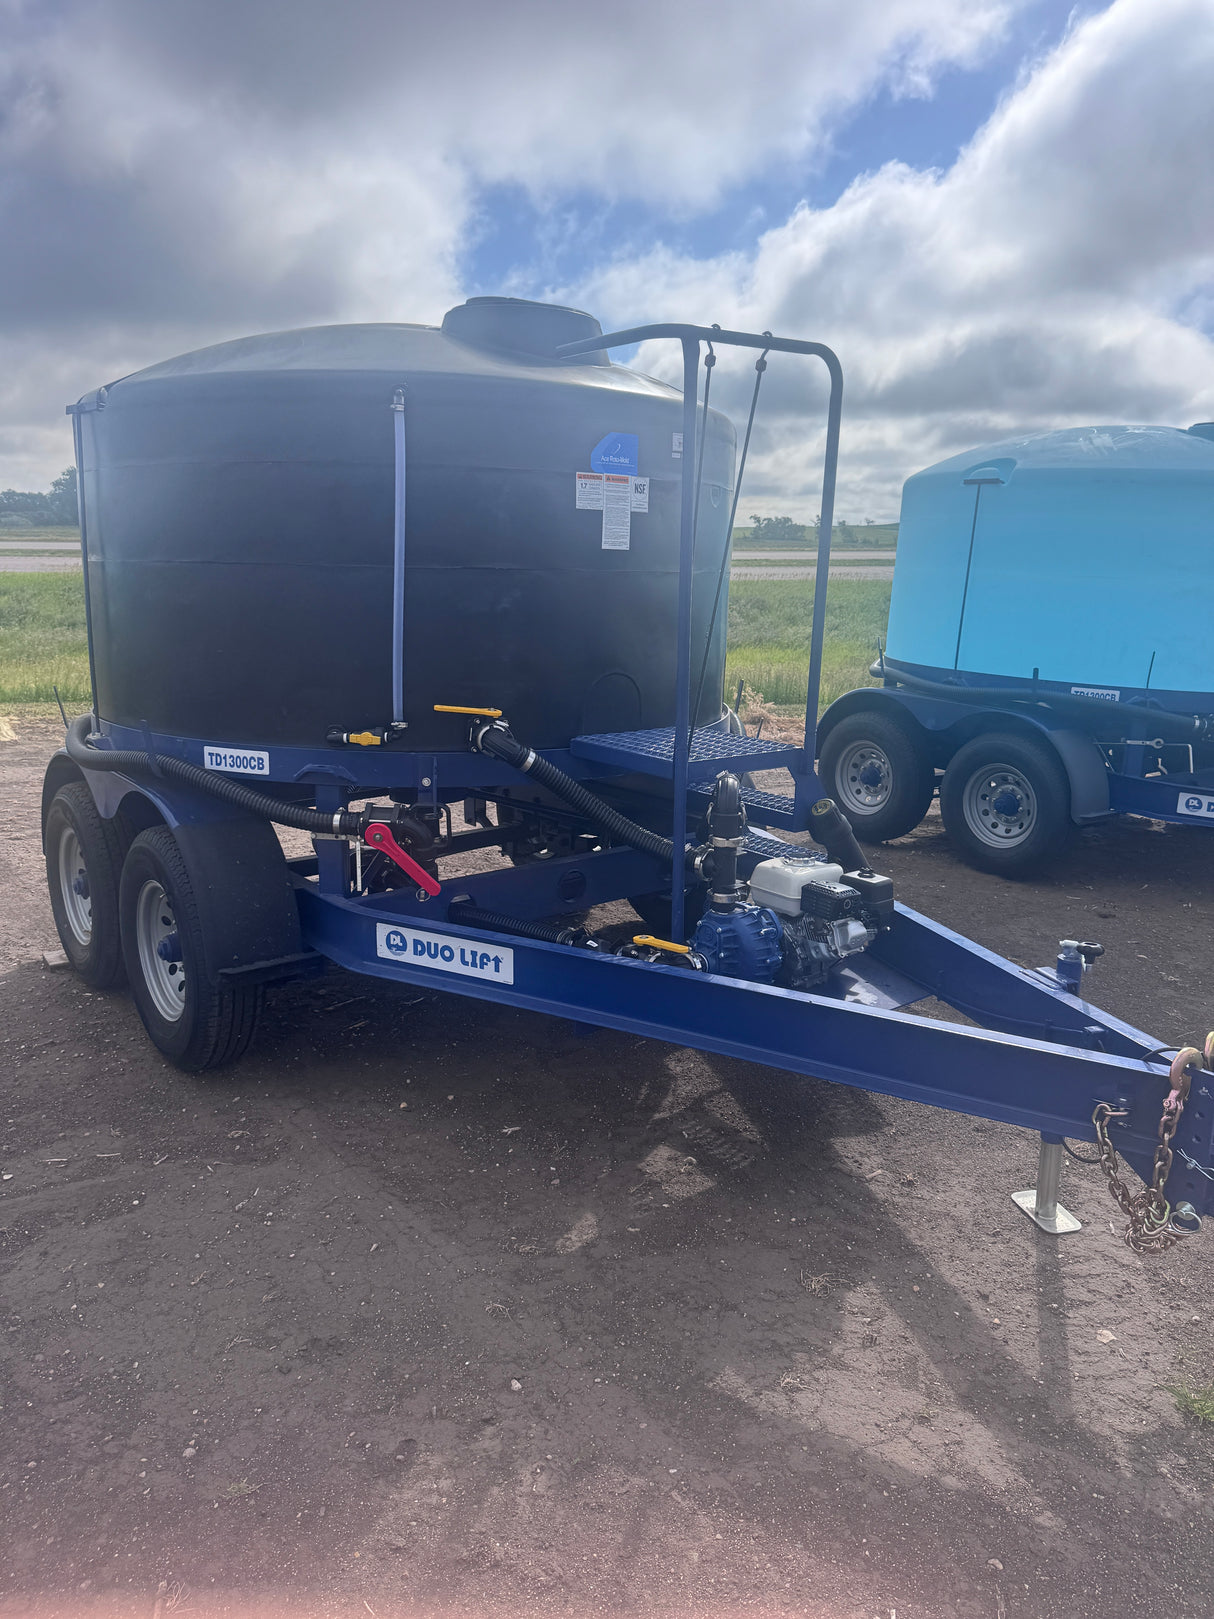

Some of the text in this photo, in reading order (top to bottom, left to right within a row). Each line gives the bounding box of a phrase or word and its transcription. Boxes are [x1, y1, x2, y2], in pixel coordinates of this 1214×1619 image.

[634, 483, 646, 494] NSF
[208, 752, 264, 770] TD1300CB
[413, 938, 455, 962] DUO
